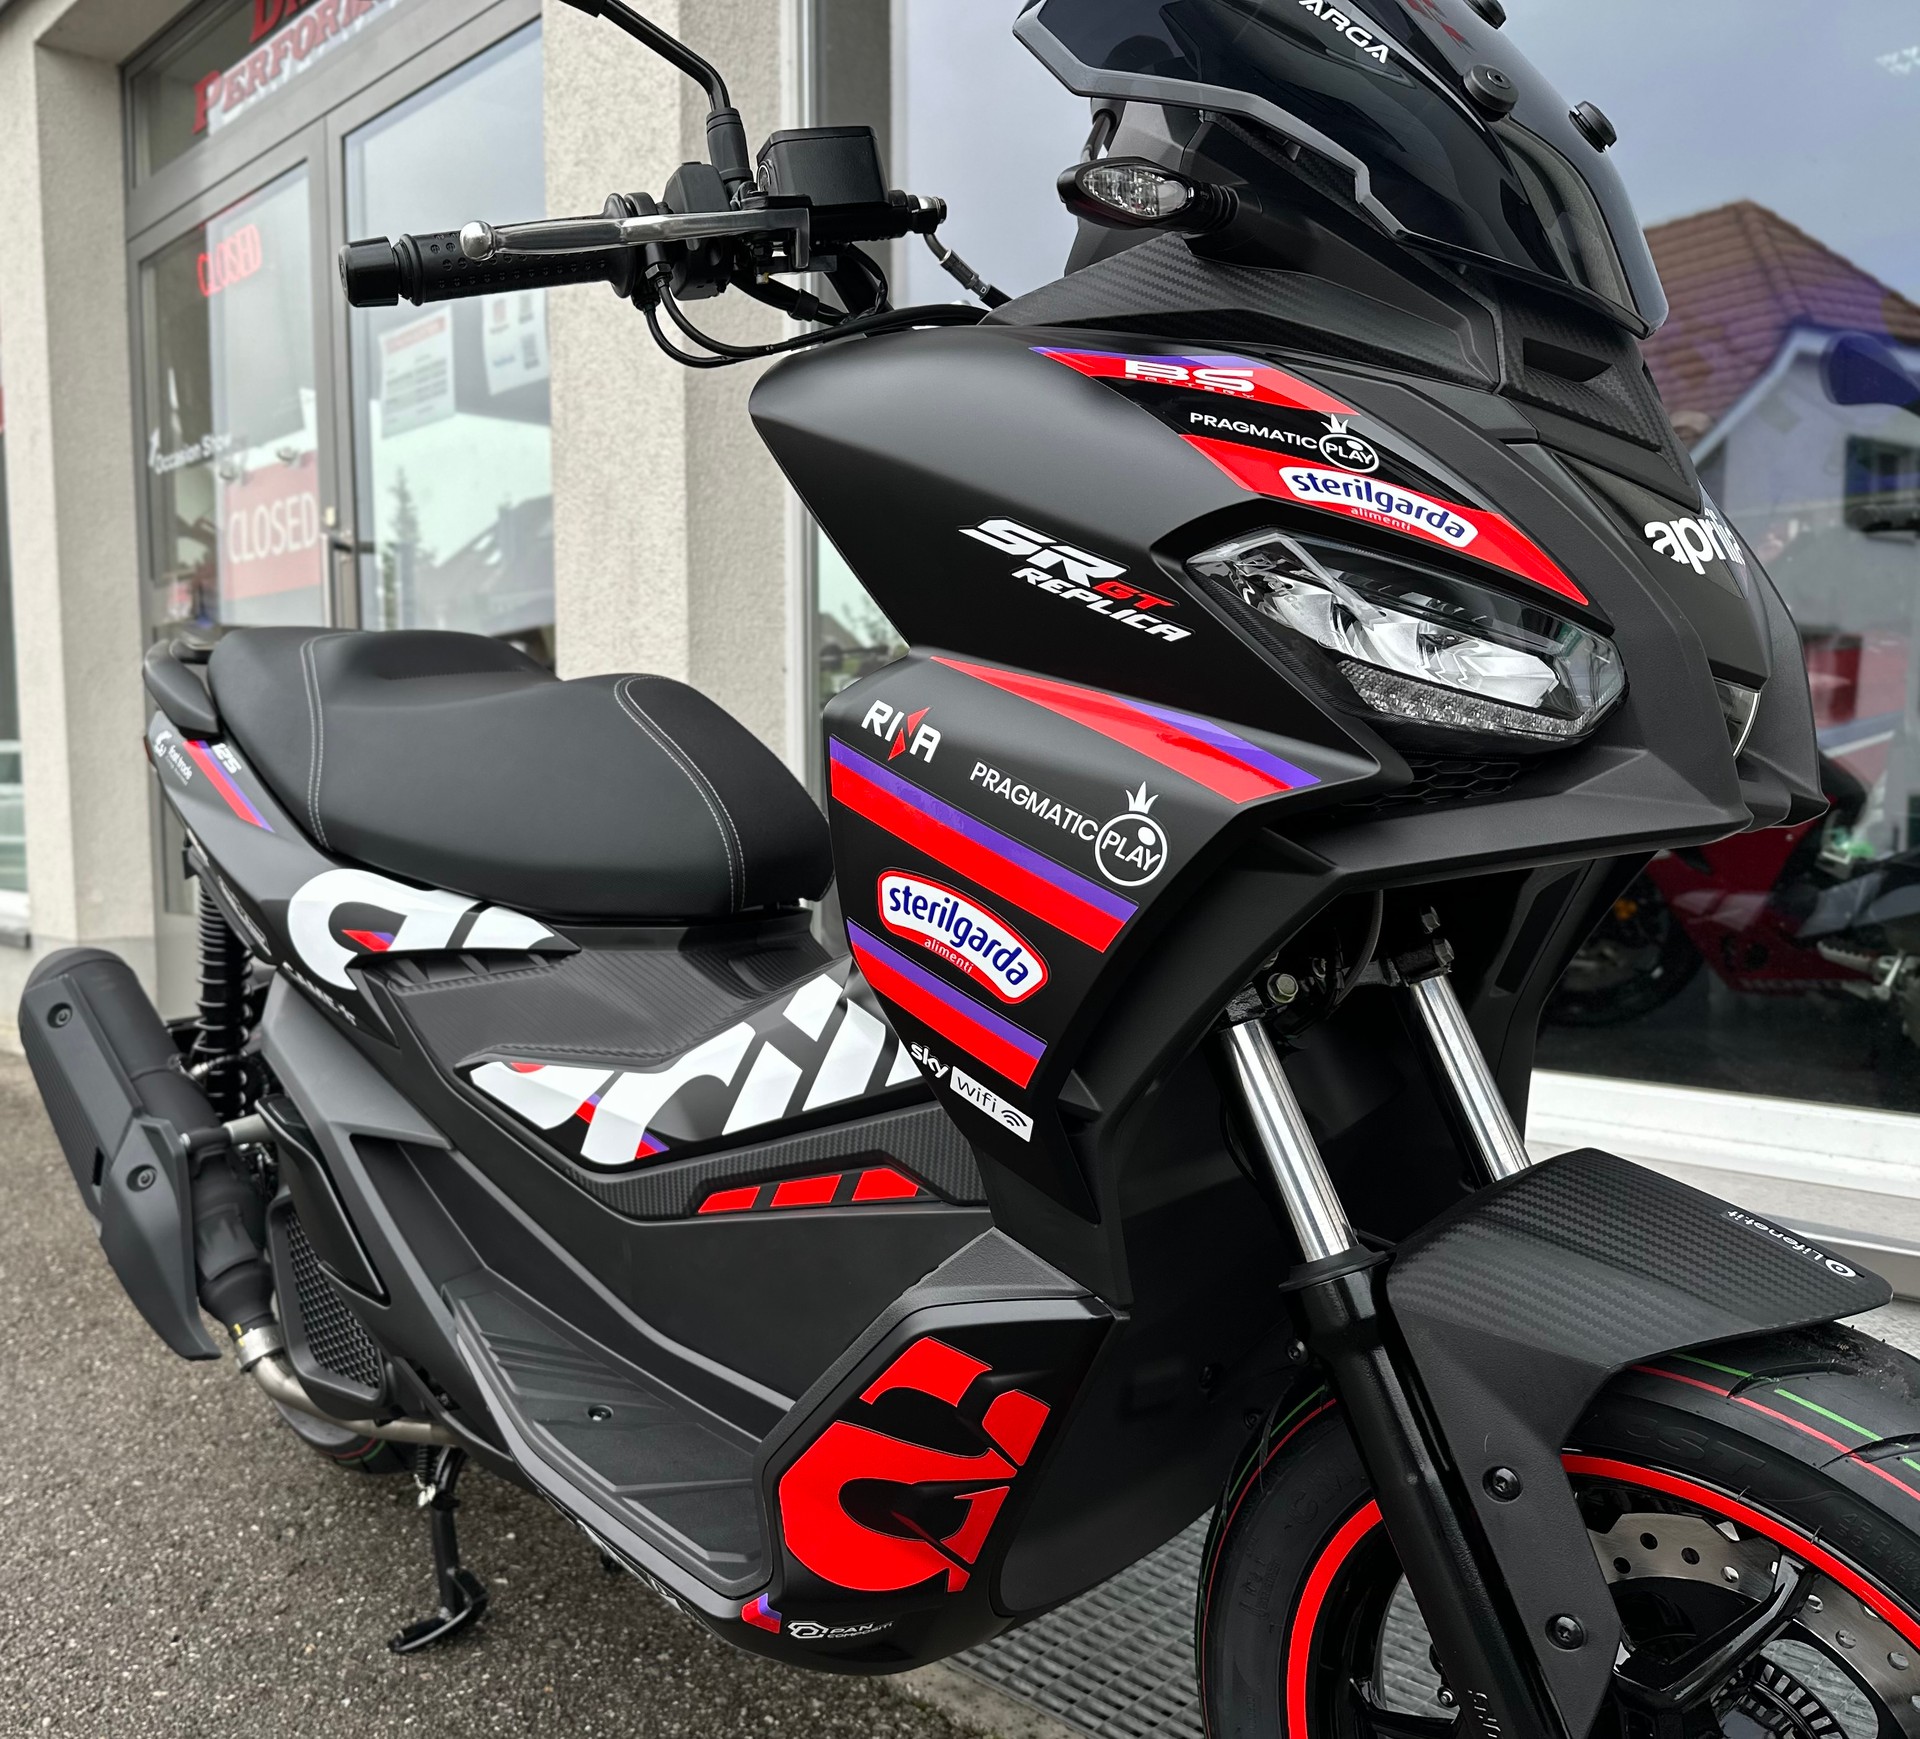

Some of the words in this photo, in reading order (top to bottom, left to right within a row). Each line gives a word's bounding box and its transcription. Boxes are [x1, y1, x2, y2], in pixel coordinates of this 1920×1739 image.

[197, 224, 263, 297] CLOSED
[1125, 360, 1255, 393] BS
[1190, 412, 1318, 449] PRAGMATIC
[1325, 442, 1374, 465] PLAY
[228, 492, 319, 564] CLOSED
[1292, 472, 1466, 540] sterilgarda
[1350, 506, 1412, 532] alimenti
[958, 519, 1127, 588] SR
[1092, 581, 1175, 610] GT
[1011, 567, 1192, 642] REPLICA
[969, 761, 1099, 842] PRAGMATIC
[1101, 830, 1161, 872] PLAY
[889, 885, 1029, 986] sterilgarda
[924, 938, 974, 975] alimenti
[910, 1041, 949, 1078] sky
[956, 1073, 999, 1114] wifi
[1727, 1210, 1824, 1261] Lifenet.it
[830, 1623, 873, 1634] PAN
